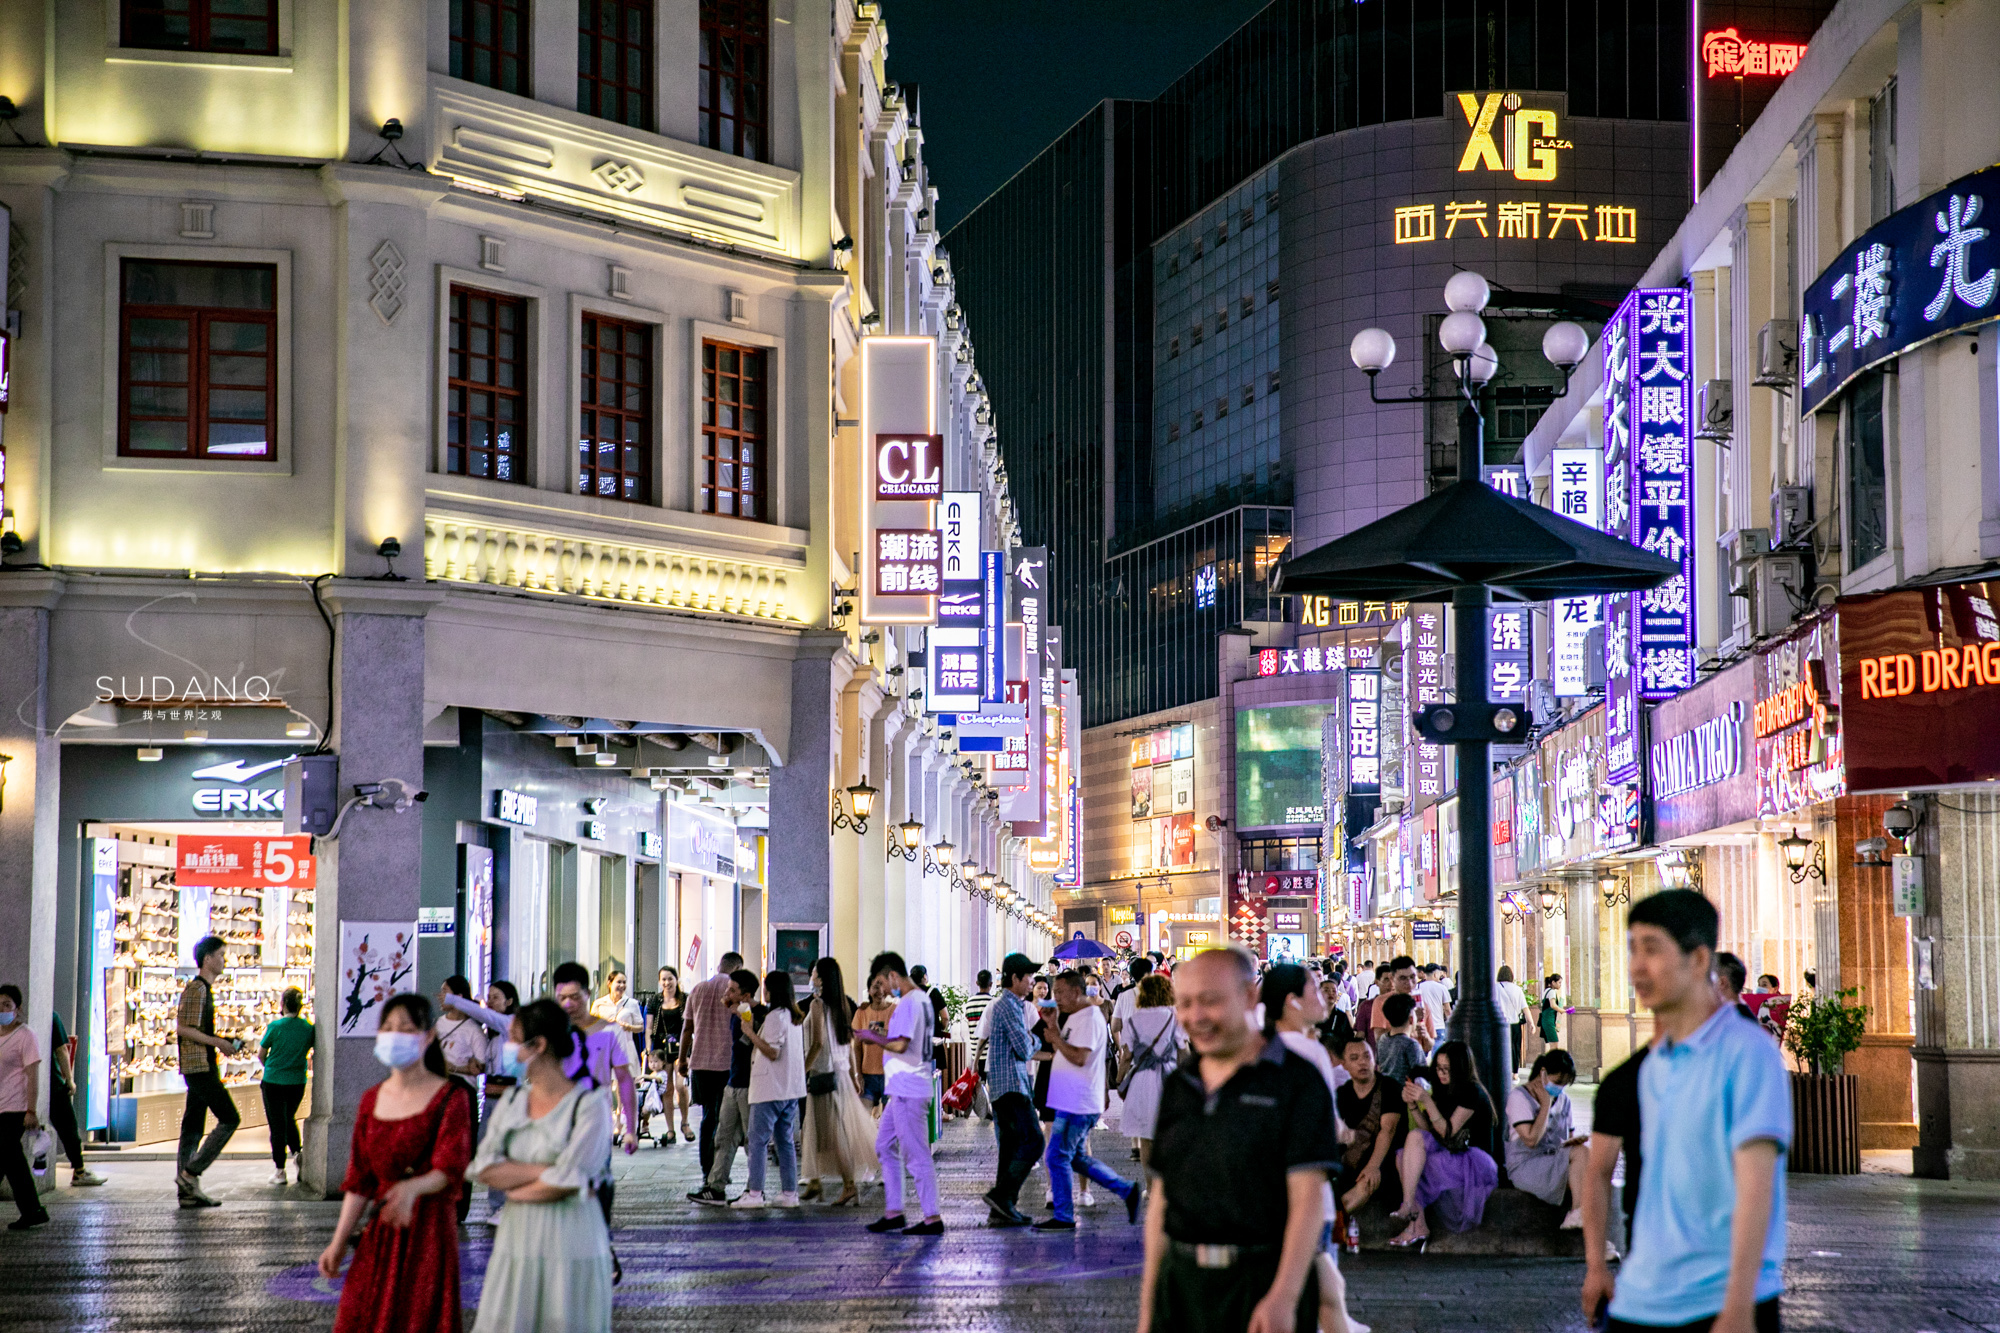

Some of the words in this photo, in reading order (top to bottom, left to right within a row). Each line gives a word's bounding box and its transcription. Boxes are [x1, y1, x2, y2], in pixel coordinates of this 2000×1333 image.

[1706, 38, 1808, 78] 熊猫网
[1533, 138, 1573, 149] PLAZA
[1395, 200, 1636, 244] 西关新天地
[1923, 194, 1997, 322] 光
[878, 440, 940, 484] CL
[1639, 295, 1687, 689] 光大眼镜平价城二楼
[879, 533, 939, 561] 潮流
[947, 502, 960, 571] ERKE
[879, 564, 939, 592] 前线
[939, 605, 981, 616] ERKE
[1860, 653, 1916, 700] RED
[1754, 699, 1766, 738] RED
[1766, 680, 1804, 733] DRAGONFLY
[263, 841, 295, 883] 5
[1283, 876, 1314, 889] 必胜客
